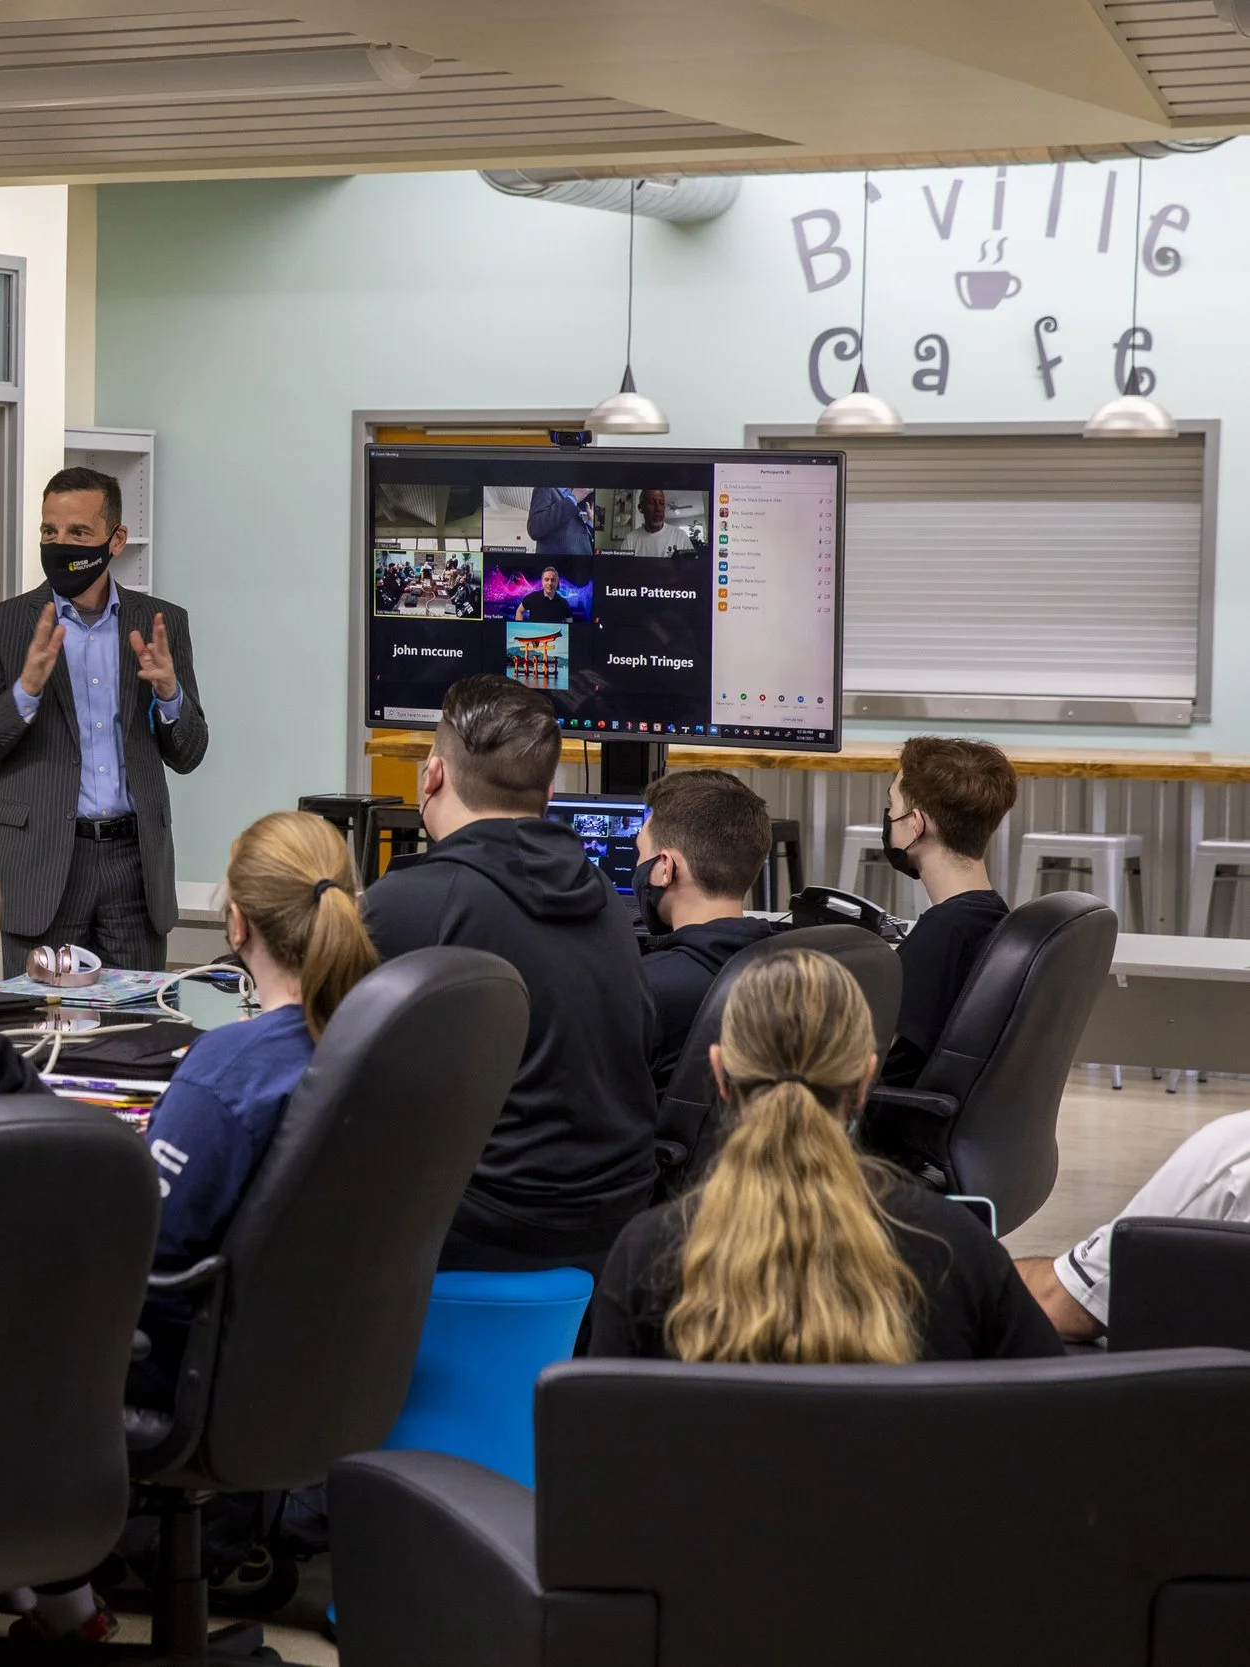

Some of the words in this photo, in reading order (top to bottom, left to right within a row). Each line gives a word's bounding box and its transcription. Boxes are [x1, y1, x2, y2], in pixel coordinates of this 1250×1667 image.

[808, 315, 1157, 406] Cafe
[606, 586, 637, 597] Laura
[640, 586, 697, 599] Patterson
[392, 644, 418, 658] john
[421, 648, 464, 658] mccune
[607, 654, 647, 668] Joseph
[650, 655, 694, 670] Tringes
